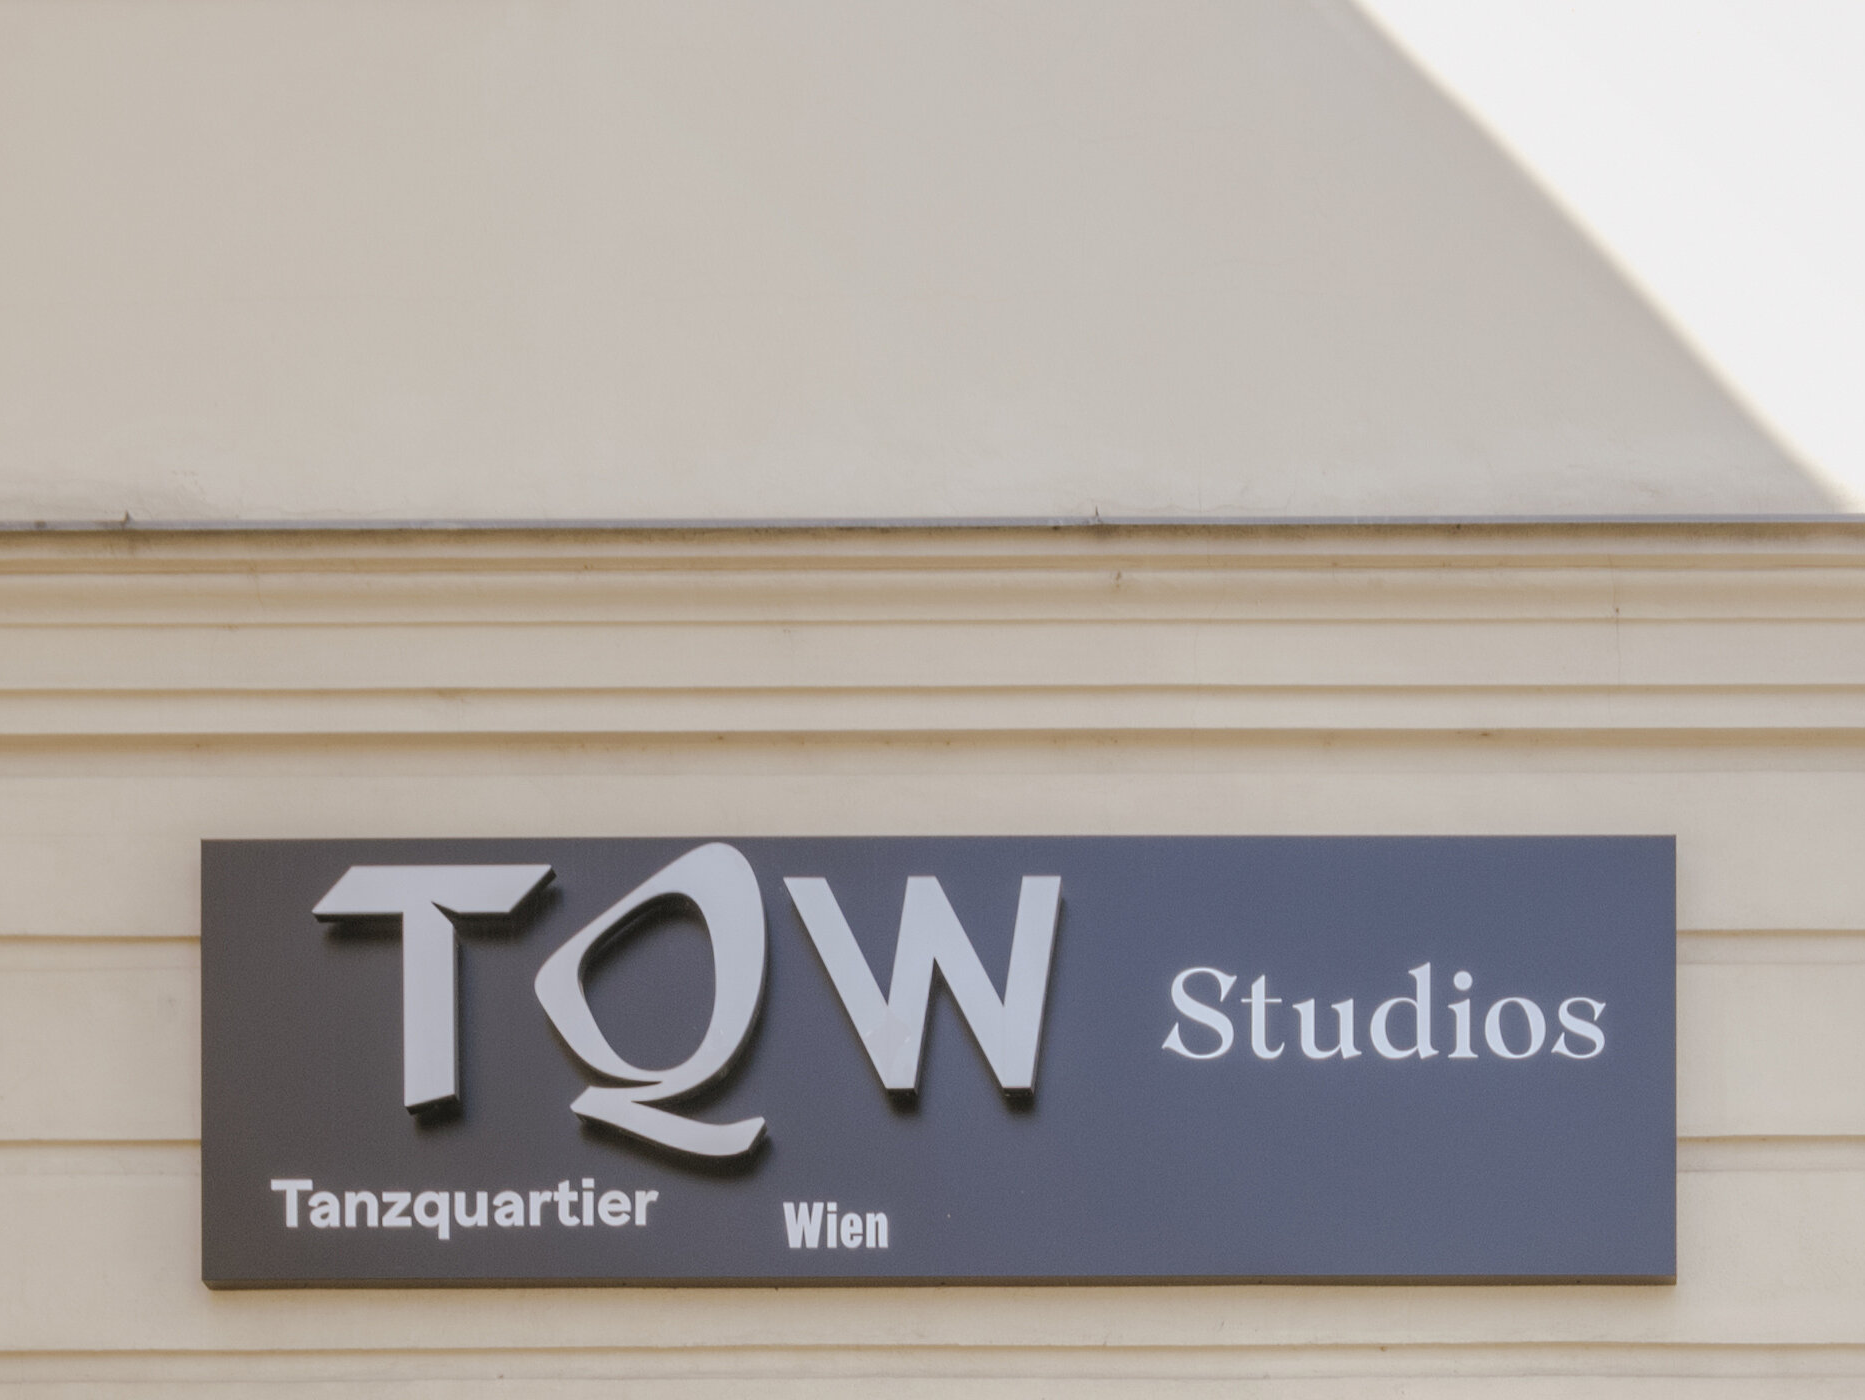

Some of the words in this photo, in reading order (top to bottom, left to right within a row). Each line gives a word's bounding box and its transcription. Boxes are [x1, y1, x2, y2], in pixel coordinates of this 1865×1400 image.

[311, 841, 1063, 1158] TQW
[1161, 961, 1607, 1060] Studios
[270, 1177, 659, 1240] Tanzquartier
[783, 1201, 889, 1250] Wien
